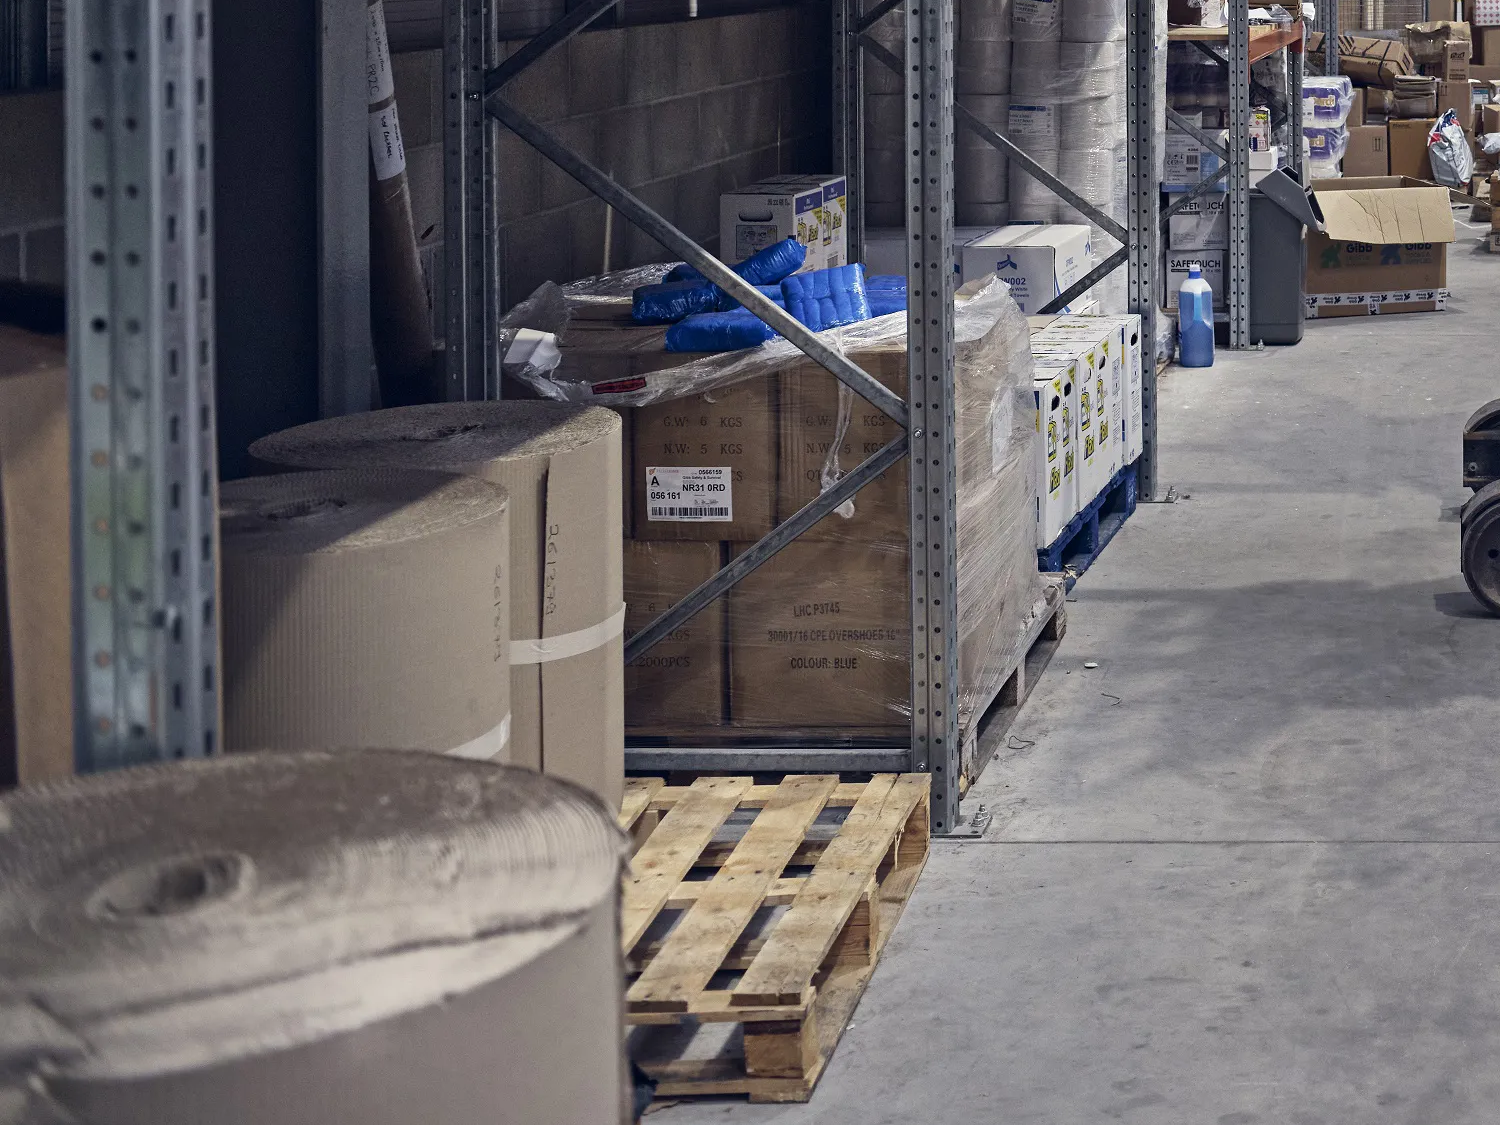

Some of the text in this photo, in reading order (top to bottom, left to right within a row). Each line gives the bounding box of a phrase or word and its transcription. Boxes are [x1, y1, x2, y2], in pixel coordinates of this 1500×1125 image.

[1346, 243, 1373, 253] Gibb
[1170, 260, 1221, 269] SAFETOUCH
[663, 416, 689, 427] G.W:
[720, 416, 742, 427] KGS
[863, 415, 885, 426] KGS
[663, 443, 743, 454] N.W: 5 KGS
[650, 476, 660, 486] A
[682, 484, 705, 492] NR31
[793, 602, 840, 617] LHC P3745
[810, 630, 828, 641] CPE
[829, 629, 885, 641] OVERSHOES
[790, 657, 858, 669] COLOUR: BLUE
